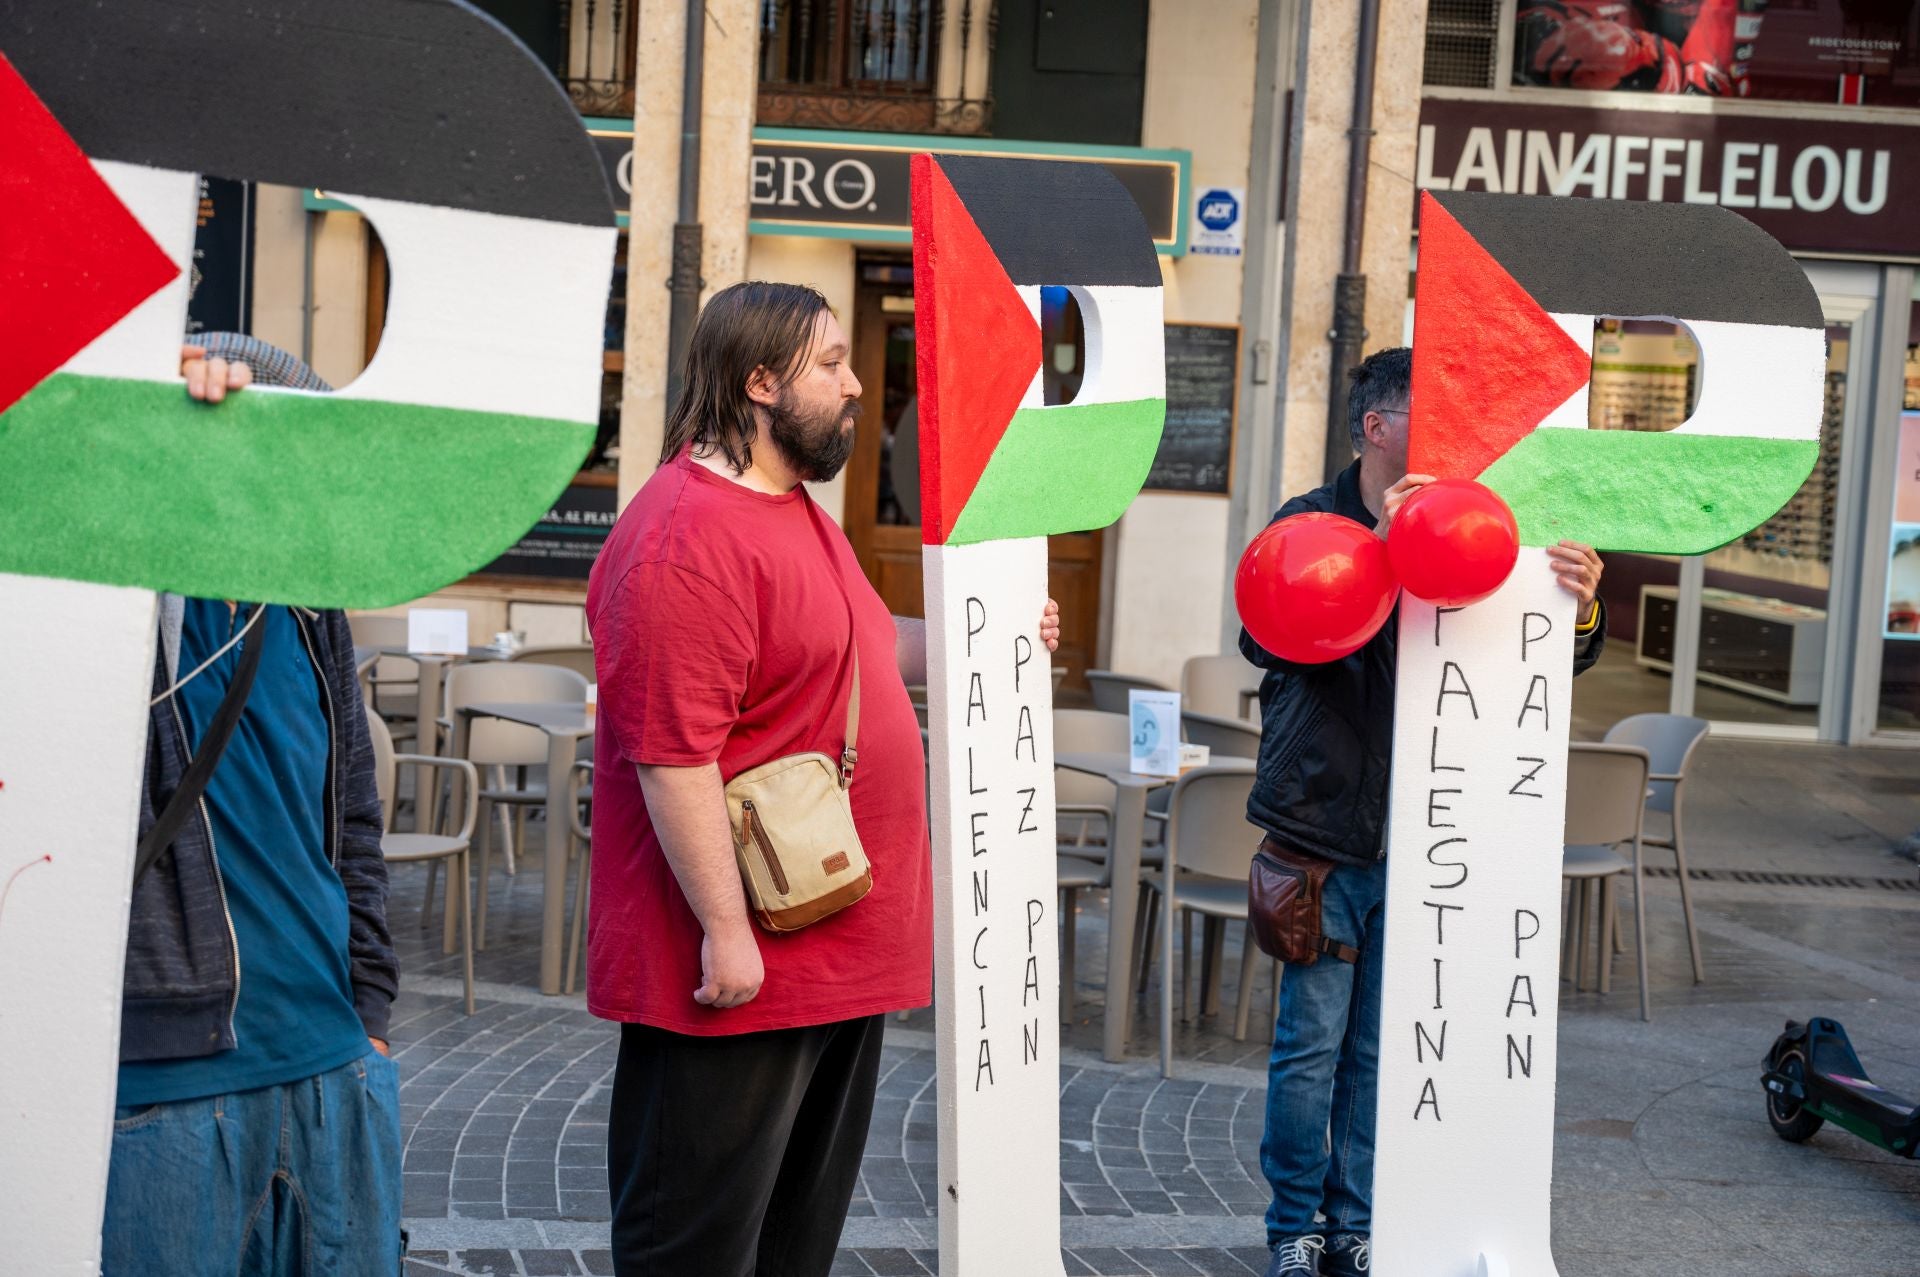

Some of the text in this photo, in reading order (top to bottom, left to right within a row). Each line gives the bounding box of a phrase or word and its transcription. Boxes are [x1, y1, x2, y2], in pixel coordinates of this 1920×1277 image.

[1202, 203, 1234, 220] ADT
[966, 597, 993, 1092] PALENCIA
[1015, 635, 1043, 1066] PAZ PAN
[1505, 612, 1552, 1079] PAZ PAN
